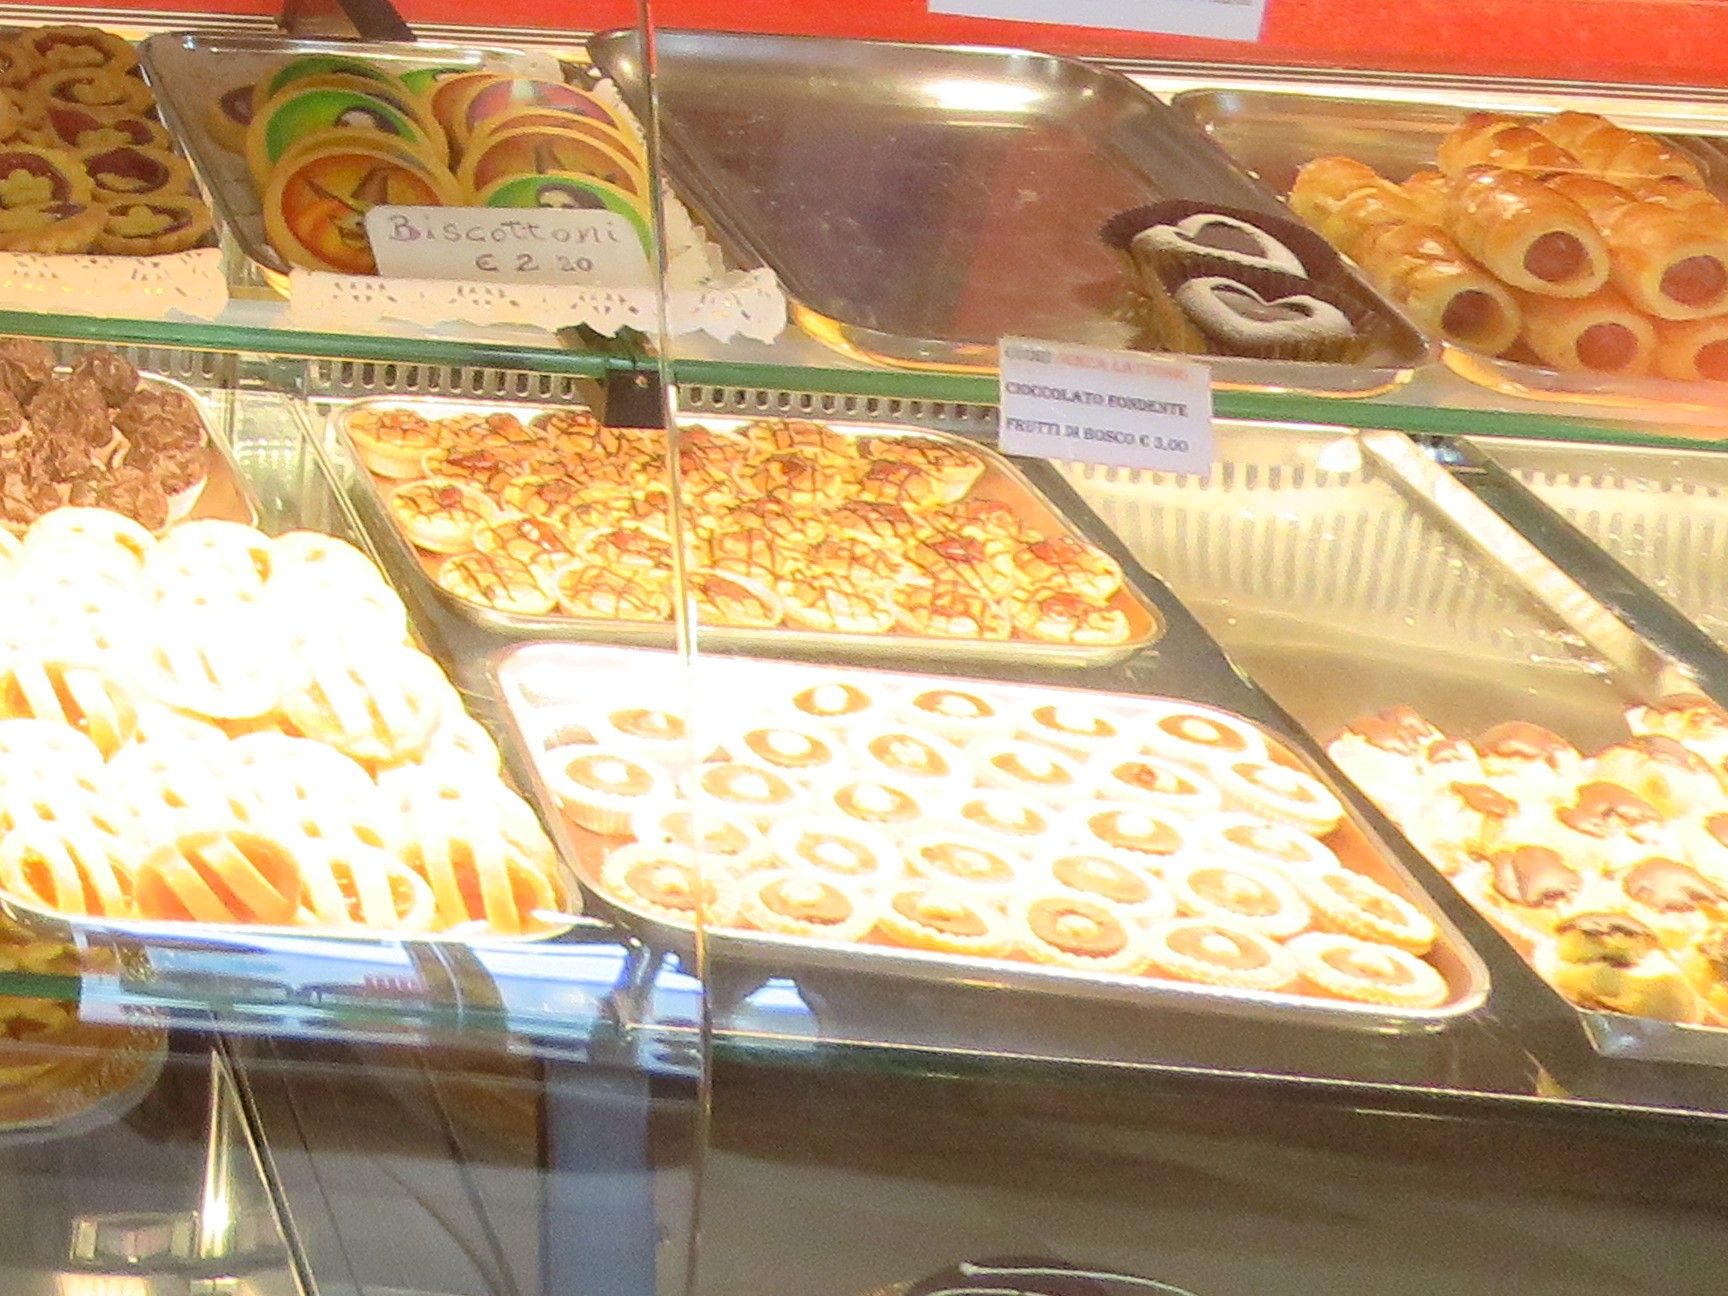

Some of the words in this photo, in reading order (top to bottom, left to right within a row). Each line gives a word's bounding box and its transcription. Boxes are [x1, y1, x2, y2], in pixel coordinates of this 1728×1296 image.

[1005, 381, 1104, 405] CIOCCOLATO
[1107, 394, 1189, 418] FONDENTE
[1006, 416, 1061, 437] FRUTTI
[1064, 425, 1080, 438] DI
[1084, 427, 1136, 446] BOSCO
